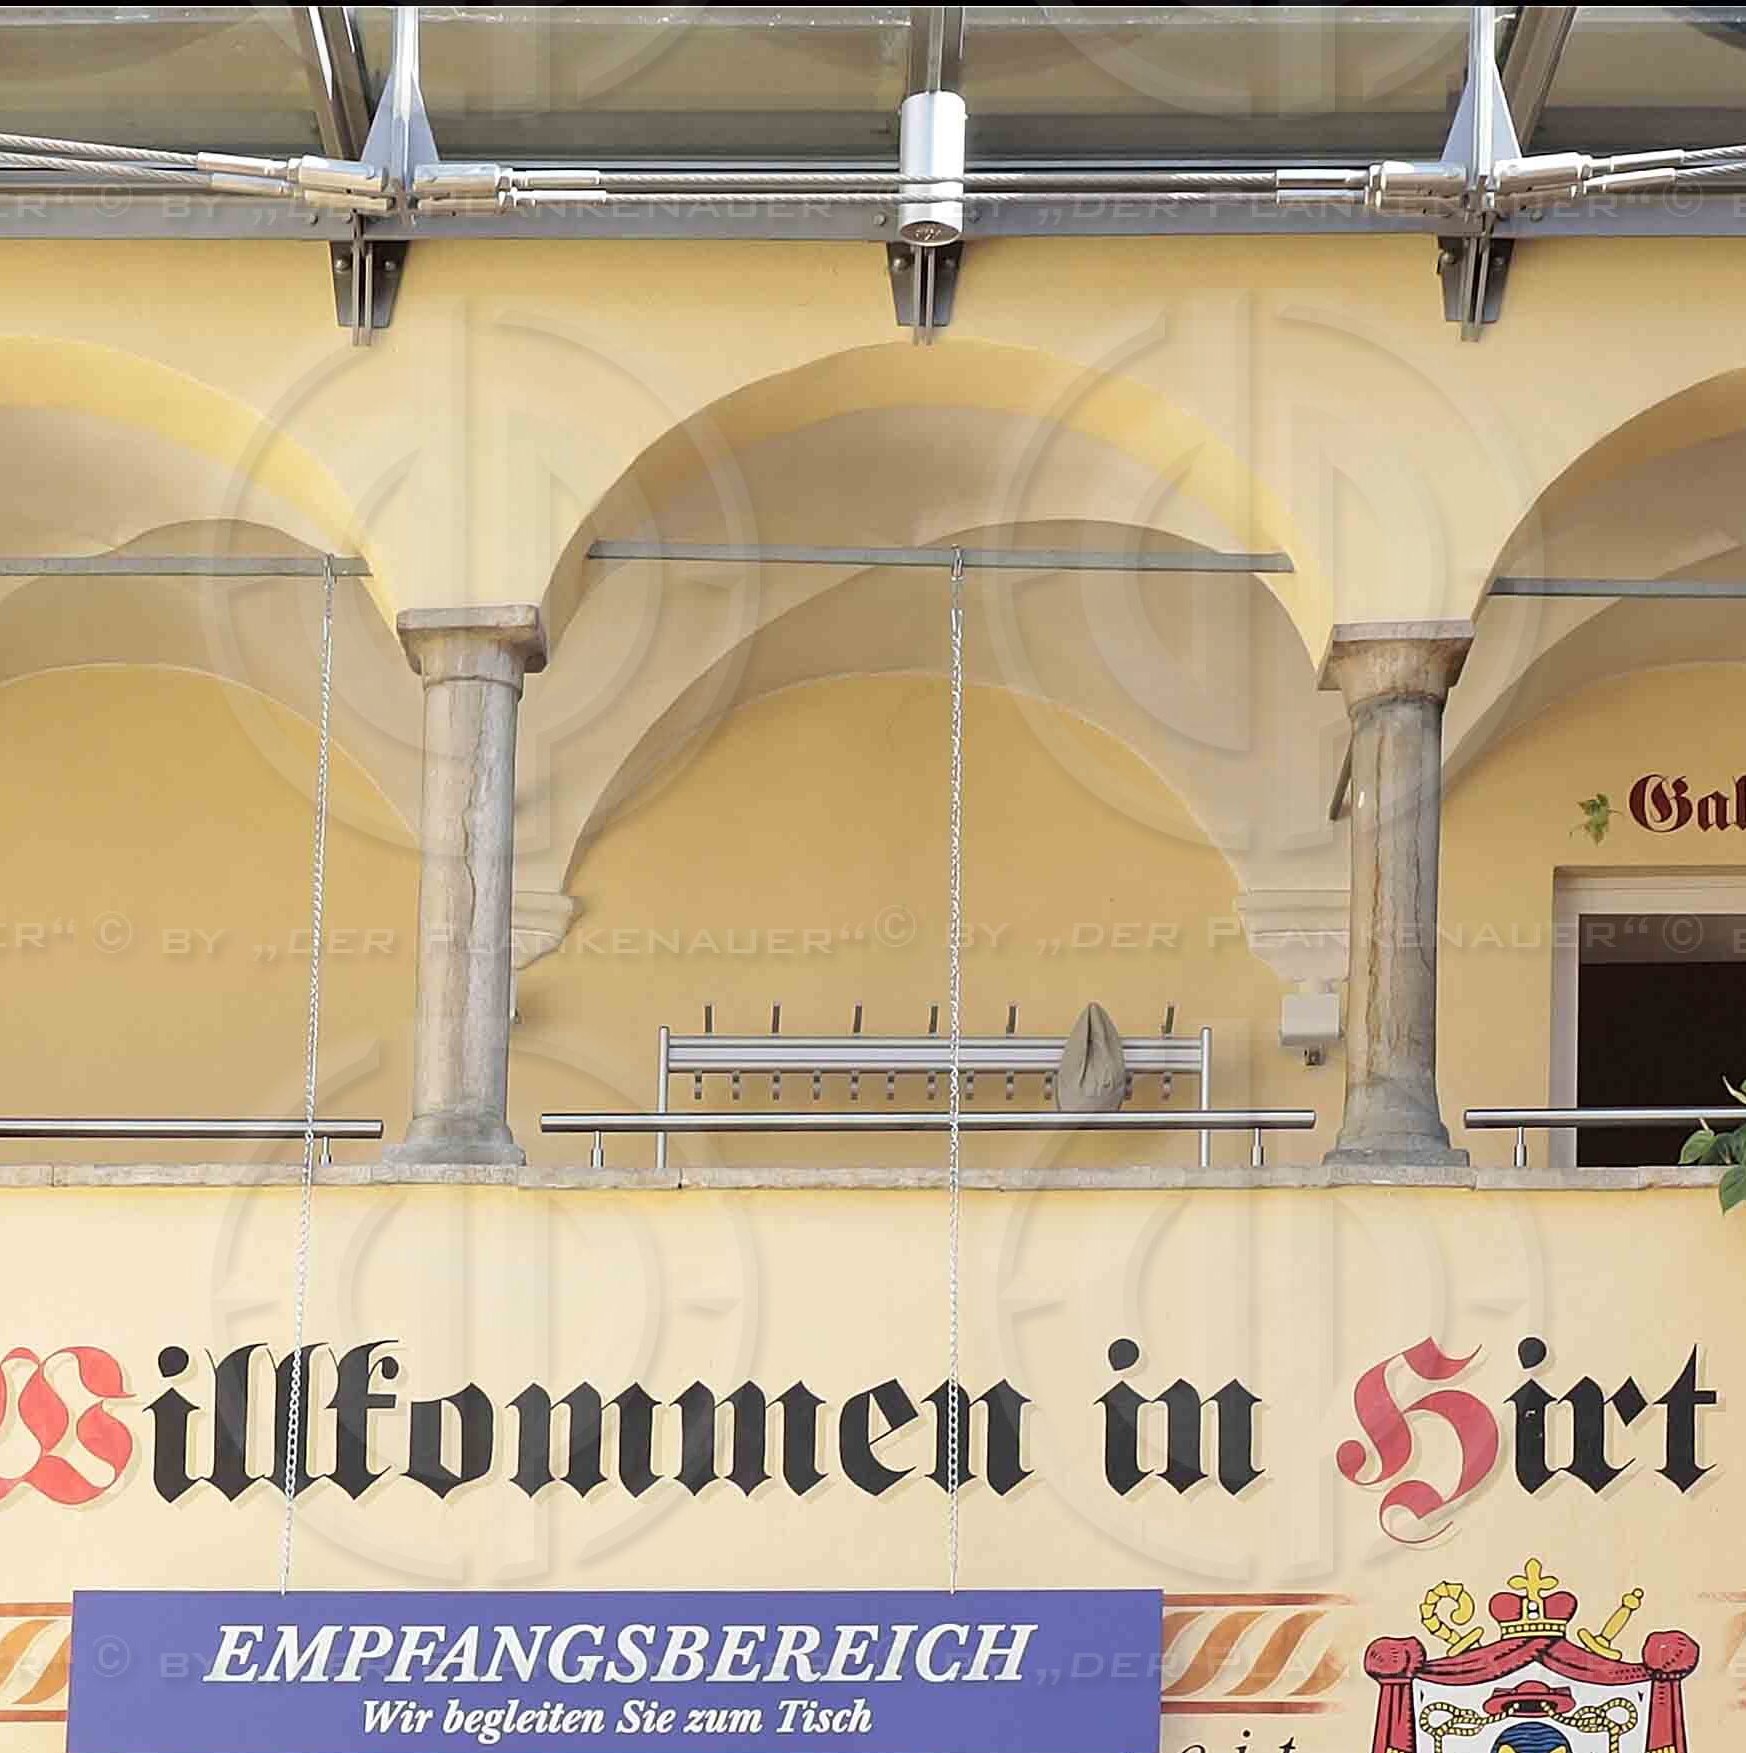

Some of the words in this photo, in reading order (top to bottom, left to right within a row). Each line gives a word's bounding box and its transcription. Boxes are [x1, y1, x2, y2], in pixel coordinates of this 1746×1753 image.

[1094, 1338, 1265, 1497] in
[1337, 1336, 1719, 1548] Hirt
[203, 1621, 1039, 1686] EMPFANGSBEREICH
[362, 1700, 434, 1732] Wir
[443, 1700, 608, 1744] begleiten
[617, 1699, 677, 1733] Sie
[685, 1710, 764, 1733] zum
[775, 1699, 872, 1734] Tisch
